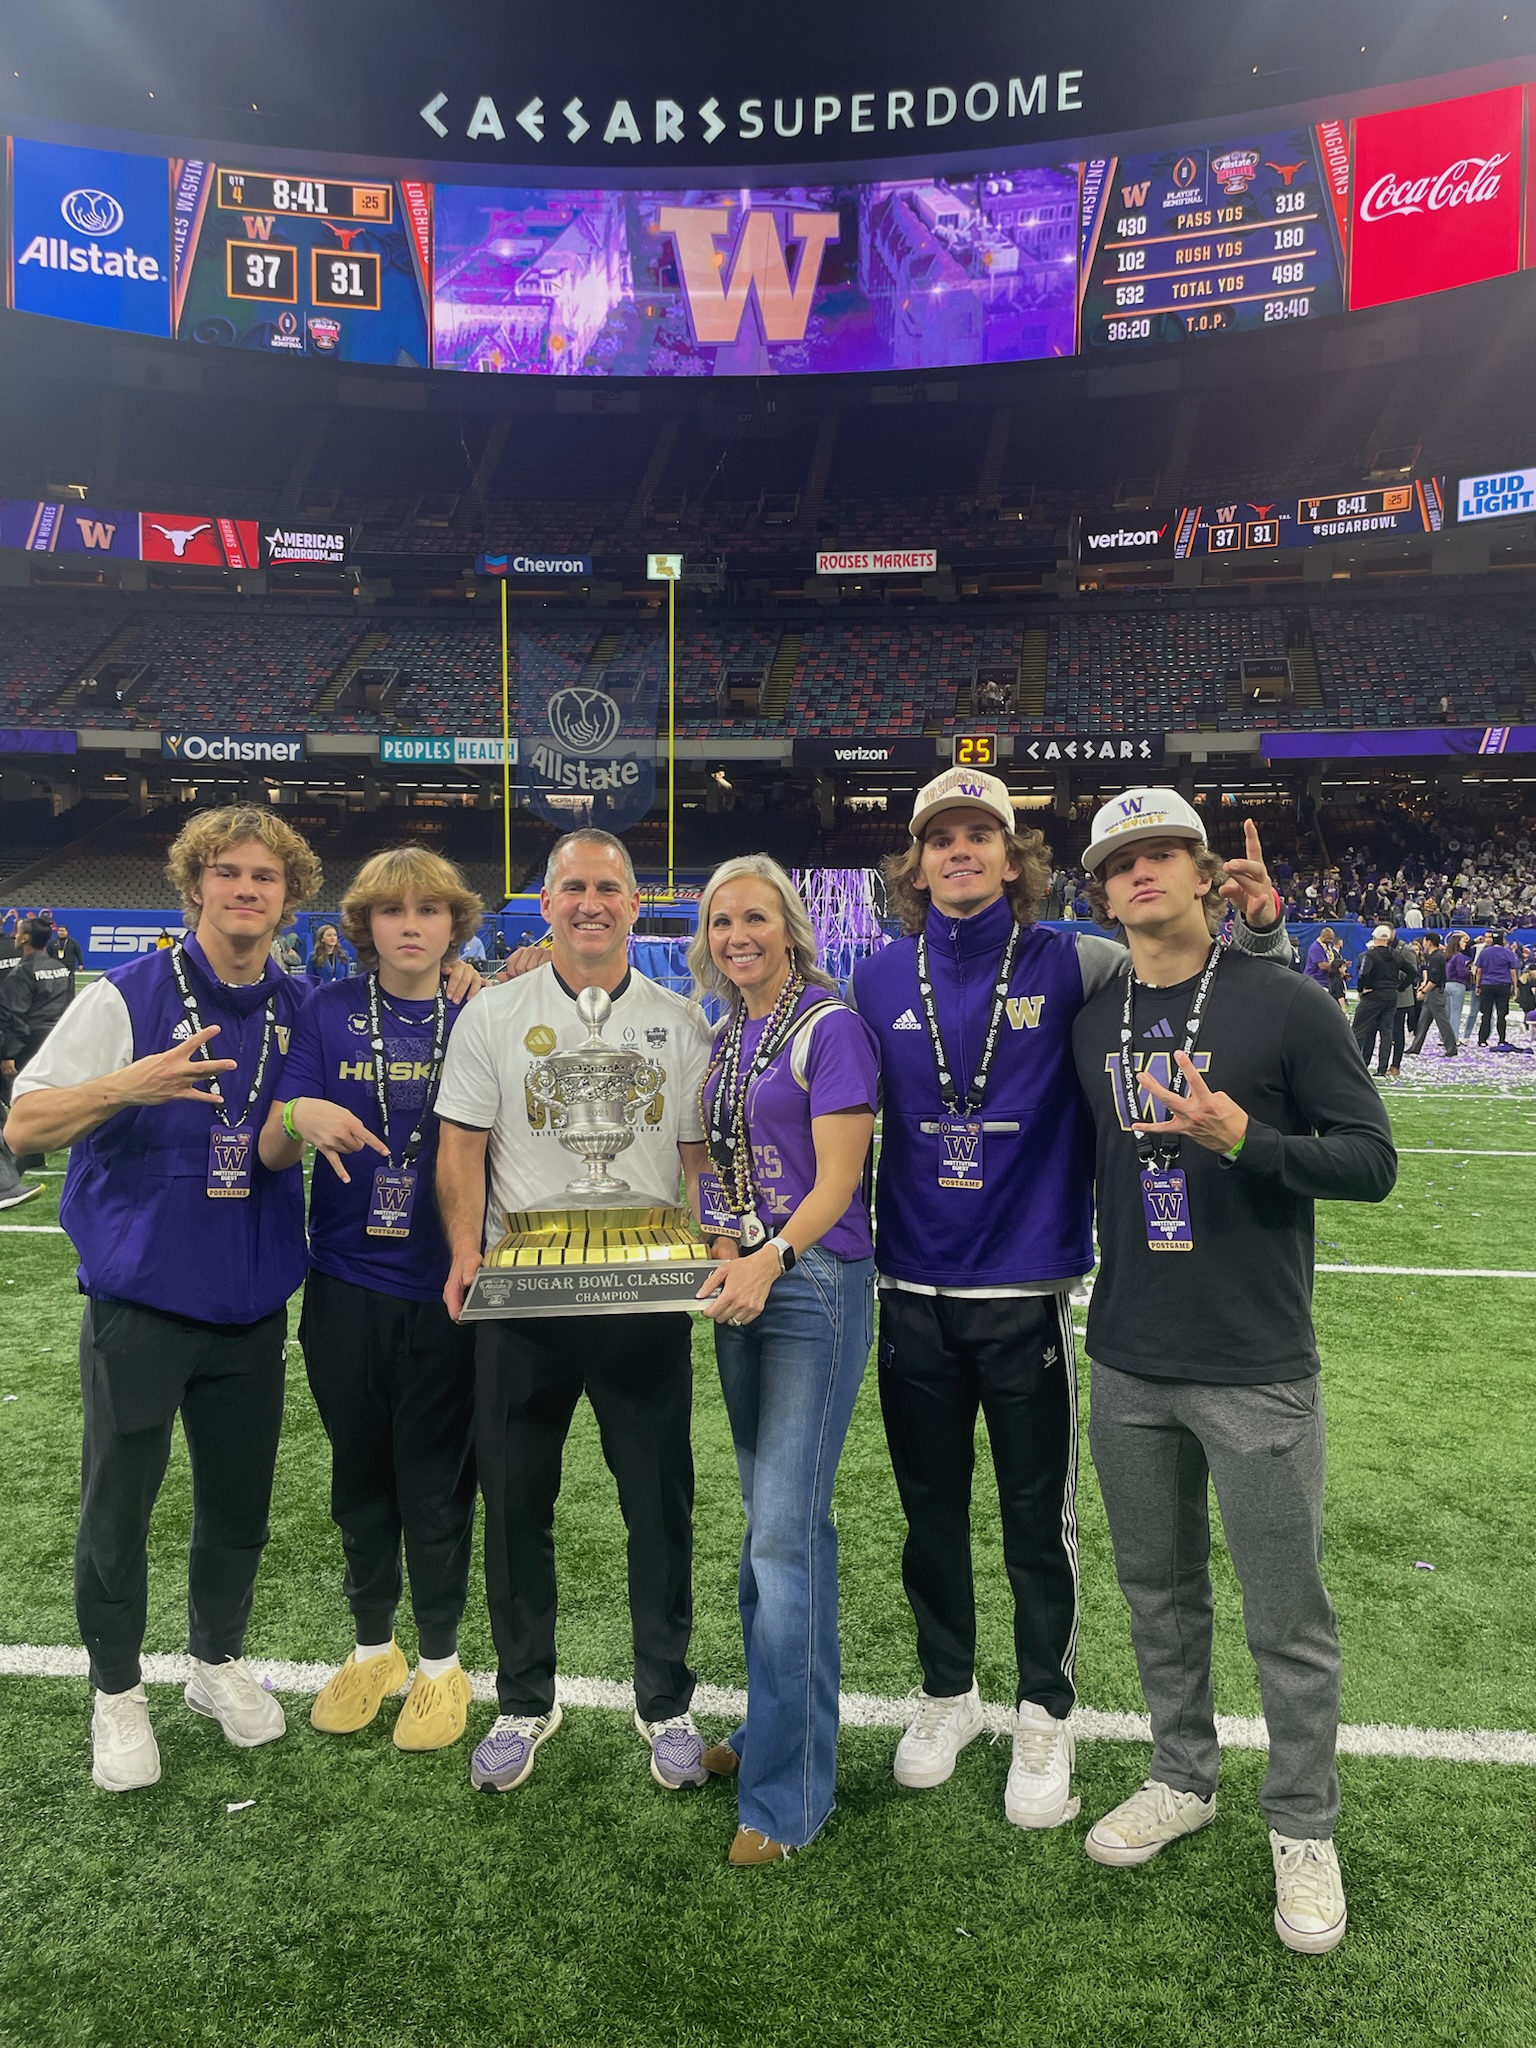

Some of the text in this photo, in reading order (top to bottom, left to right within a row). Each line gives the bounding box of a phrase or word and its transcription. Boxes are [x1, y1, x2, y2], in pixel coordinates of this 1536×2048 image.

[420, 70, 1084, 144] CAESARS SUPERDOME
[1220, 159, 1251, 170] Allstate
[228, 176, 244, 186] QTR
[1360, 152, 1511, 222] Coca-Cola
[232, 186, 242, 204] 4
[273, 180, 328, 214] 8:41
[1121, 180, 1151, 208] W
[1166, 188, 1200, 200] PLAYOFF
[1117, 192, 1305, 238] 430 PASS YDS 318
[242, 216, 276, 240] W
[18, 236, 160, 281] Allstate
[1117, 227, 1304, 272] 102 RUSH YDS 180
[246, 255, 281, 288] 37
[330, 263, 364, 296] 31
[657, 206, 840, 346] W
[1116, 262, 1304, 306] 532 TOTAL YDS 498
[1107, 297, 1310, 342] 36:20 T.O.P. 23:40
[1473, 476, 1524, 498] BUD
[1216, 504, 1238, 524] W
[1310, 507, 1318, 520] 4
[1337, 496, 1368, 516] 8:41
[1462, 490, 1532, 516] LIGHT
[76, 518, 116, 550] W
[1254, 525, 1272, 543] 31
[1313, 516, 1398, 536] #SUGARBOWL
[266, 528, 344, 550] AMERICAS
[1088, 529, 1158, 549] verizon
[1216, 529, 1234, 546] 37
[274, 548, 344, 562] CARDROOM.NET
[512, 556, 584, 574] Chevron
[818, 550, 934, 570] ROUSES MARKETS
[183, 736, 300, 762] Ochsner
[384, 741, 516, 759] PEOPLES HEALTH
[834, 747, 889, 762] verizon
[958, 738, 990, 762] 25
[1026, 740, 1150, 761] CAESARS
[528, 744, 640, 790] Allstate
[958, 784, 984, 798] W
[1119, 796, 1144, 816] W
[1000, 959, 1011, 978] Bowl
[1200, 971, 1214, 996] Sugar
[1006, 995, 1045, 1030] W
[1193, 994, 1206, 1014] Bowl
[892, 1021, 922, 1030] adidas
[925, 998, 946, 1068] Allstate Sugar Bowl
[980, 998, 1004, 1072] Allstate Sugar Bowl
[766, 1035, 780, 1054] Bowl
[1124, 1065, 1133, 1090] Sugar
[1126, 1089, 1140, 1120] Allstate
[944, 1136, 978, 1160] W
[941, 1180, 980, 1188] POSTGAME
[1148, 1193, 1184, 1220] W
[704, 1226, 740, 1236] POSTGAME
[516, 1272, 695, 1292] SUGAR BOWL CLASSIC
[575, 1290, 639, 1302] CHAMPION
